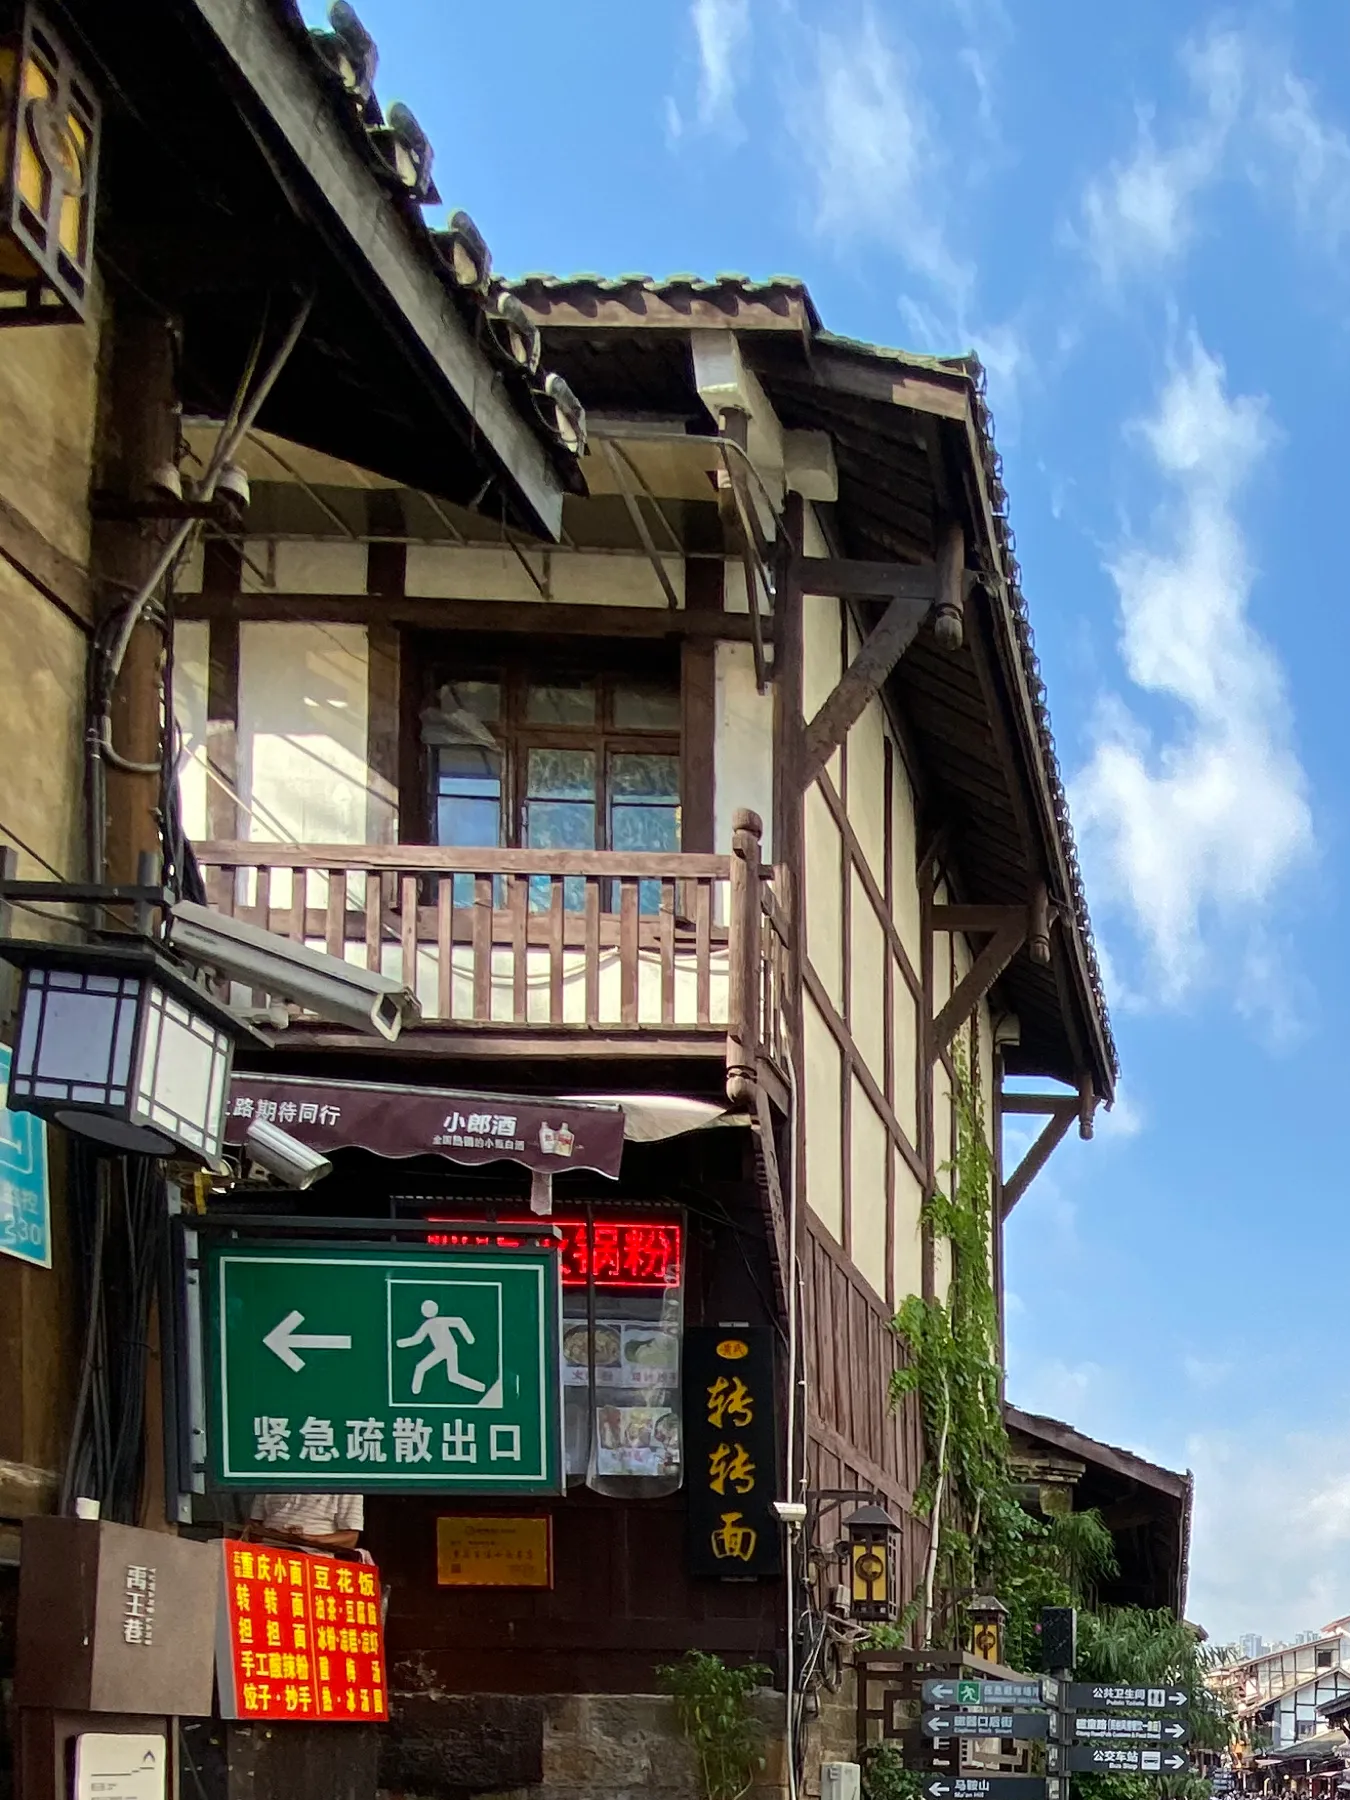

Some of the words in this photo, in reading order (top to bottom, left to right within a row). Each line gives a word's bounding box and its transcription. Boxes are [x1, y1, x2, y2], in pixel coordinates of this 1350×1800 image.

[442, 1112, 517, 1138] 小郎酒
[252, 1416, 521, 1464] 紧急疏散出口
[707, 1376, 757, 1562] 转转面
[313, 1565, 375, 1597] 豆花饭
[123, 1564, 147, 1644] 禹王巷
[1092, 1687, 1146, 1700] 公共卫生间
[1093, 1750, 1139, 1763] 公交车站
